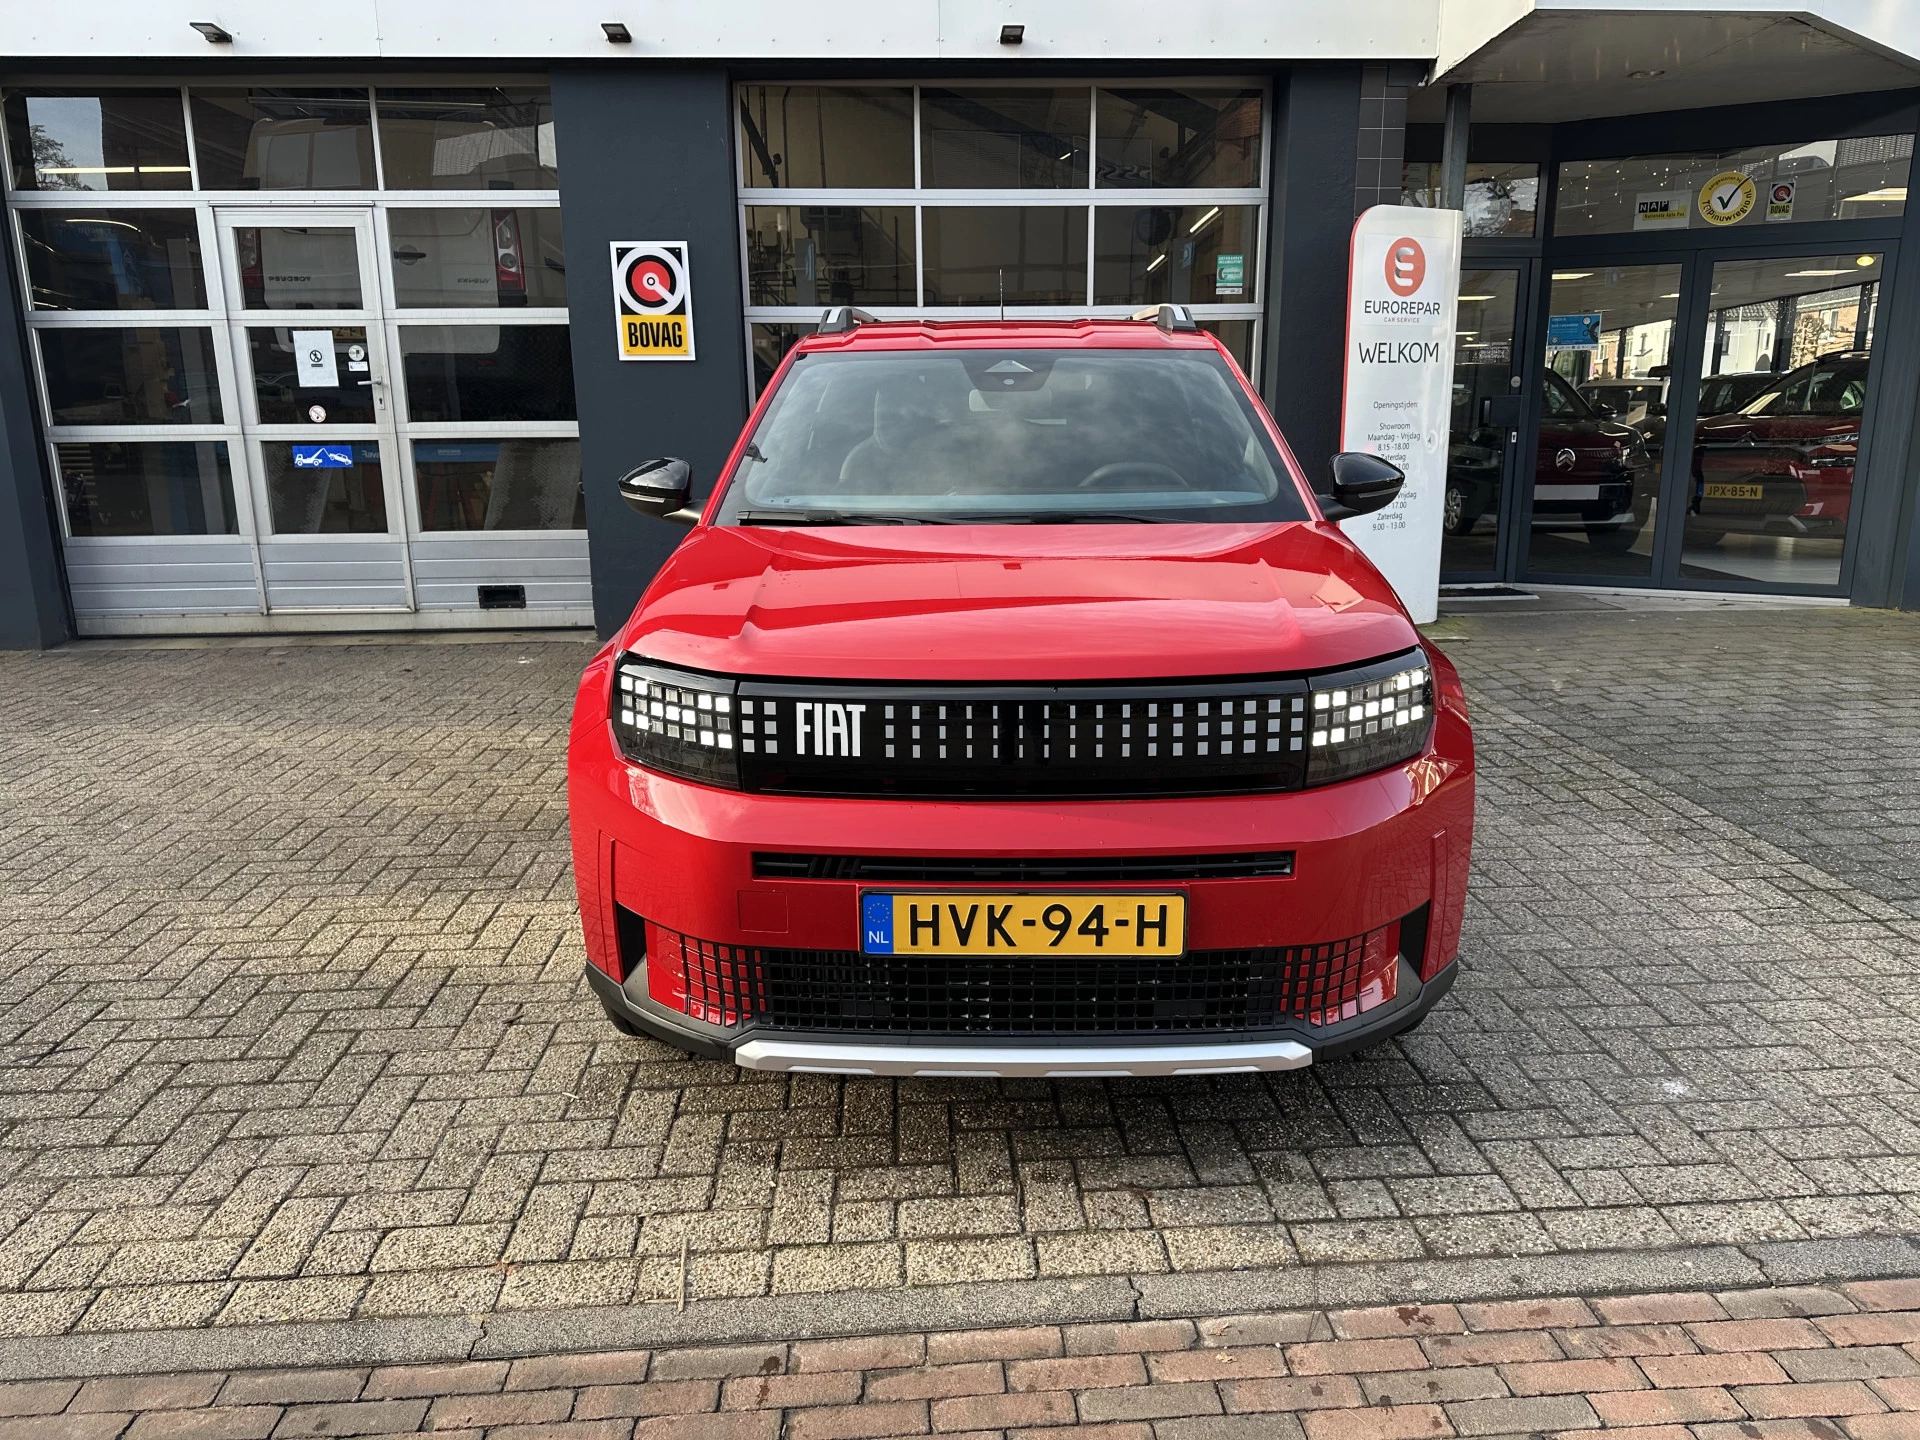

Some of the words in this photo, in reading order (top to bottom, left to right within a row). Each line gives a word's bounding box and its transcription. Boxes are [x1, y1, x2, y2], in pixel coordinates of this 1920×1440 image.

[1639, 200, 1668, 212] NAP
[1770, 204, 1790, 214] BOVAG
[1364, 300, 1441, 315] EUROREPAR
[627, 321, 683, 348] BOVAG
[1358, 342, 1439, 363] WELKOM
[1379, 422, 1411, 430] Showroom
[1367, 434, 1395, 442] Maandag
[1400, 432, 1421, 441] Vrijdag
[1706, 485, 1758, 497] JPX-85-N
[1391, 501, 1407, 509] 17.00
[1377, 512, 1403, 521] Zaterdag
[1372, 523, 1385, 531] 9.00
[1390, 521, 1406, 530] 13.00
[796, 702, 866, 757] FIAT
[909, 903, 1166, 947] HVK-94-H
[868, 930, 889, 944] NL
